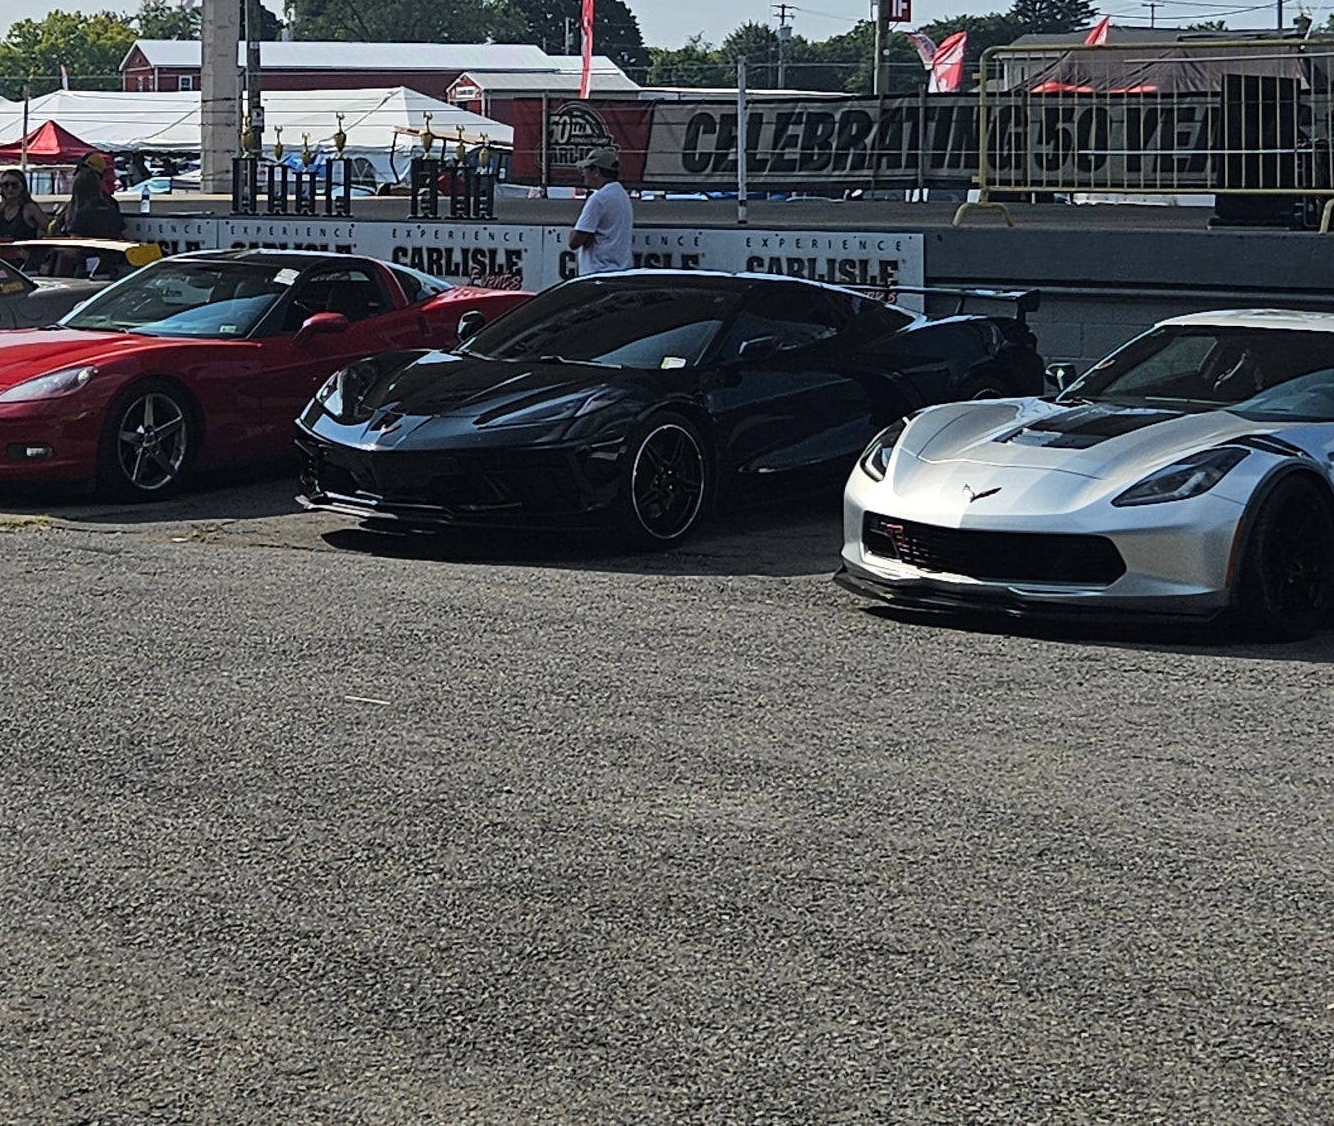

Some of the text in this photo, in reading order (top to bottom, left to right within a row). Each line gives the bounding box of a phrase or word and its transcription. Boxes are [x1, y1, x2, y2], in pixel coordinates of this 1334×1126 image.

[682, 106, 1028, 174] CELEBRATING
[1035, 106, 1111, 173] 50
[230, 226, 353, 238] EXPERIENCE
[392, 228, 524, 243] EXPERIENCE
[746, 237, 903, 252] EXPERIENCE
[392, 245, 524, 277] CARLISLE
